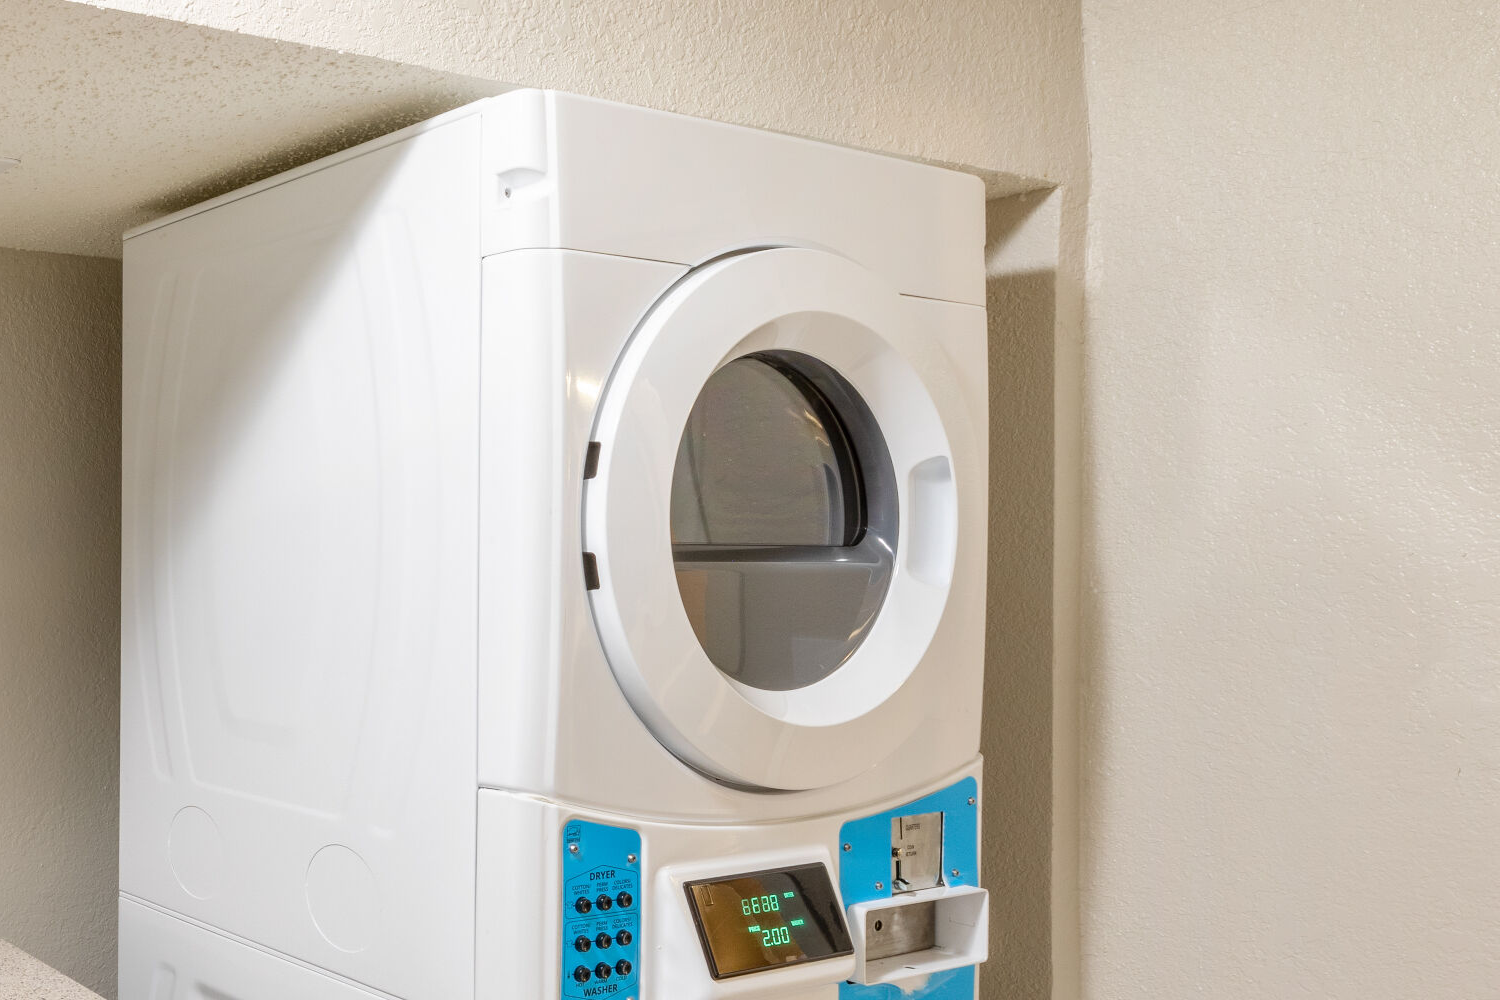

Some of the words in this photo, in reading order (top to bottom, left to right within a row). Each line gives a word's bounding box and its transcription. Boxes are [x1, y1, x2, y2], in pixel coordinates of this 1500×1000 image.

[589, 870, 615, 880] DRYER
[762, 927, 790, 947] 2.00
[583, 984, 618, 997] WASHER
